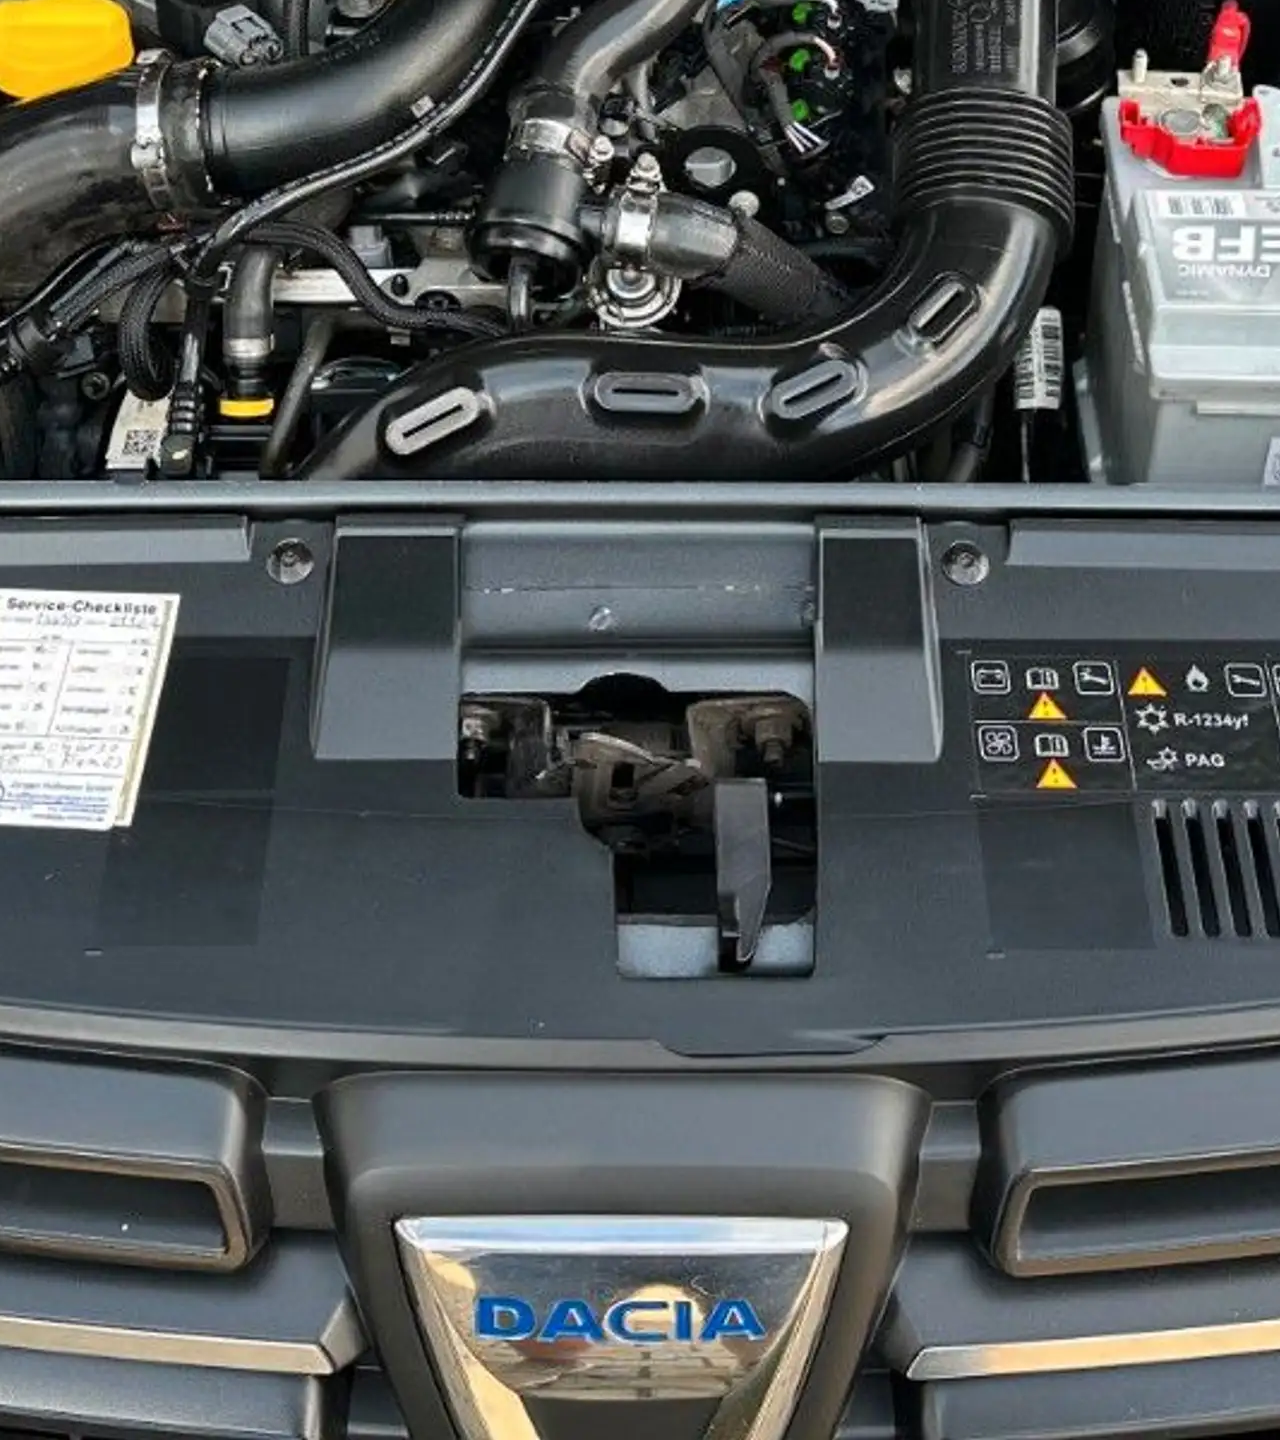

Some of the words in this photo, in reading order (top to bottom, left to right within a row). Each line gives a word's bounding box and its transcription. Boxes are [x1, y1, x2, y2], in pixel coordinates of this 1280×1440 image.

[1178, 263, 1271, 278] DYNAMIC
[6, 596, 158, 616] Service-Checkliste
[474, 1294, 767, 1343] DACIA
